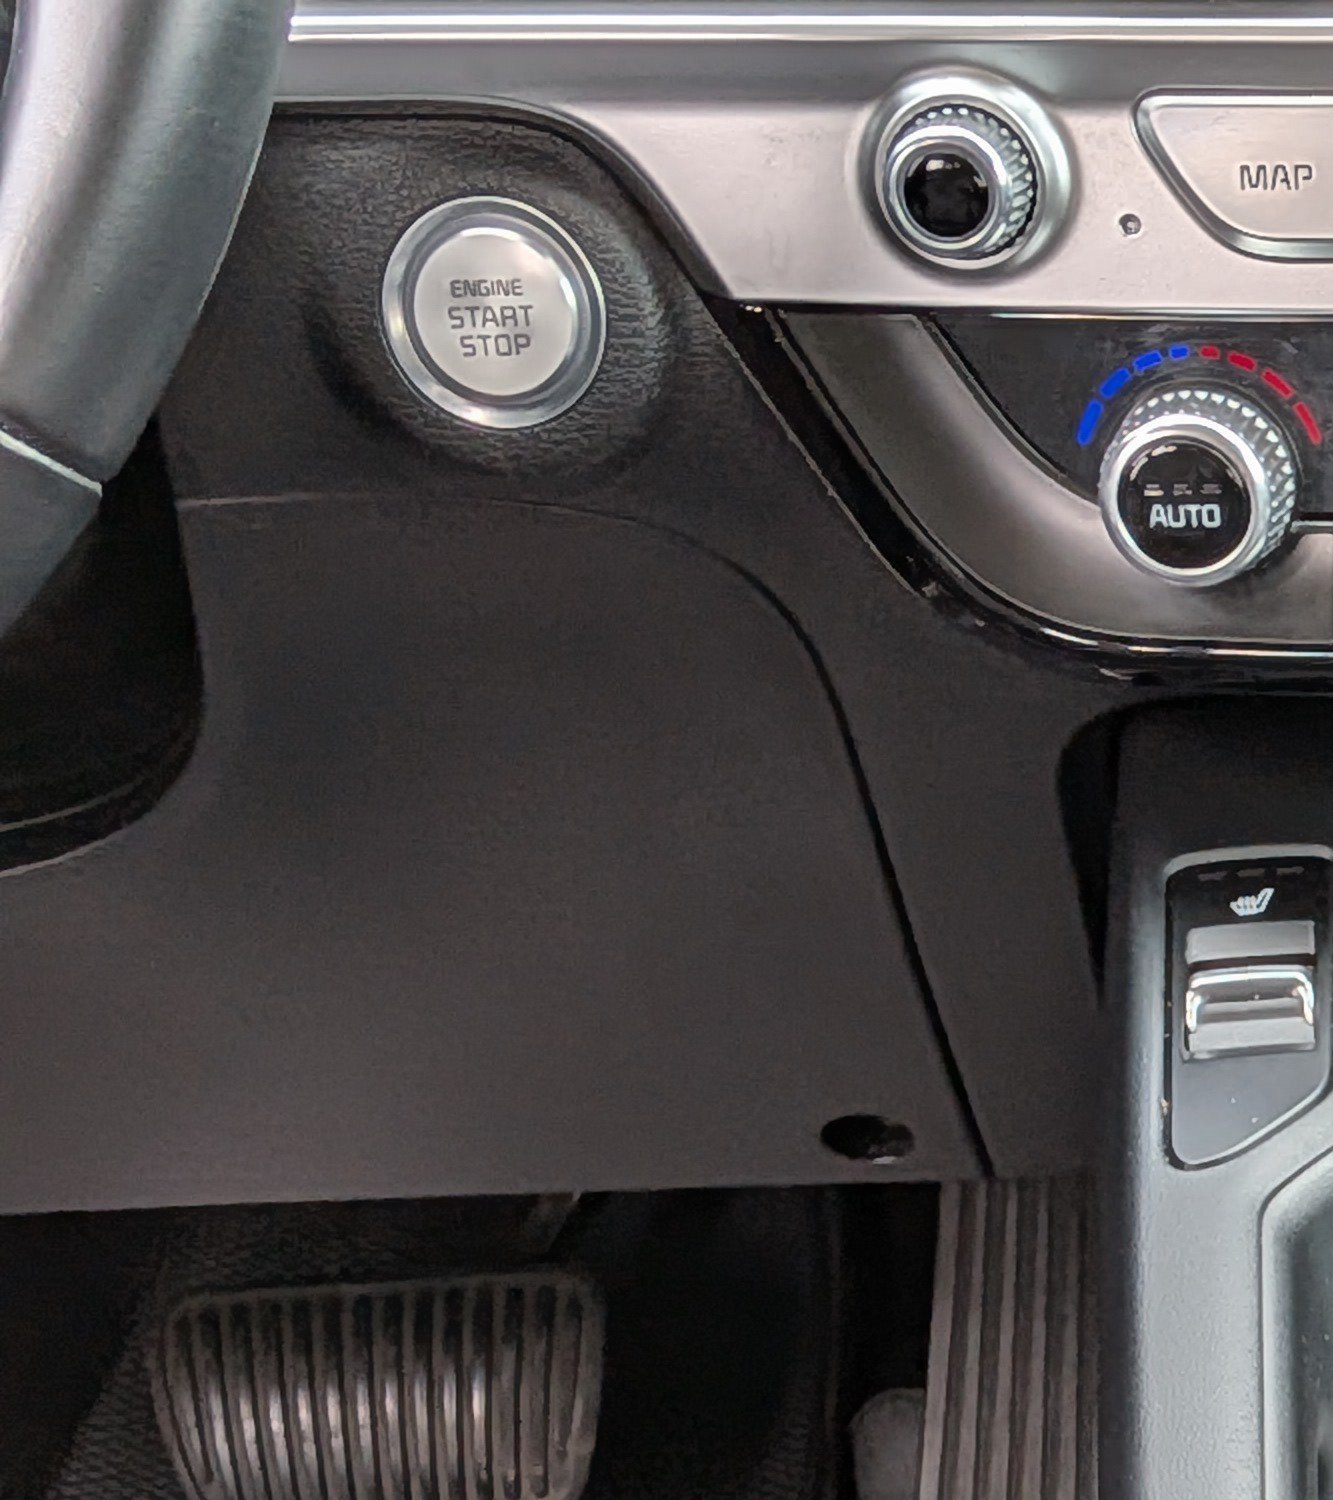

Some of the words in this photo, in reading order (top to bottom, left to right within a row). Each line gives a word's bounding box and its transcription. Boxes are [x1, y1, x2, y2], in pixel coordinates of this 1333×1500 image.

[1238, 163, 1314, 192] MAP
[450, 278, 524, 299] ENGINE
[447, 304, 534, 330] START
[459, 333, 532, 358] STOP
[1149, 503, 1222, 529] AUTO
